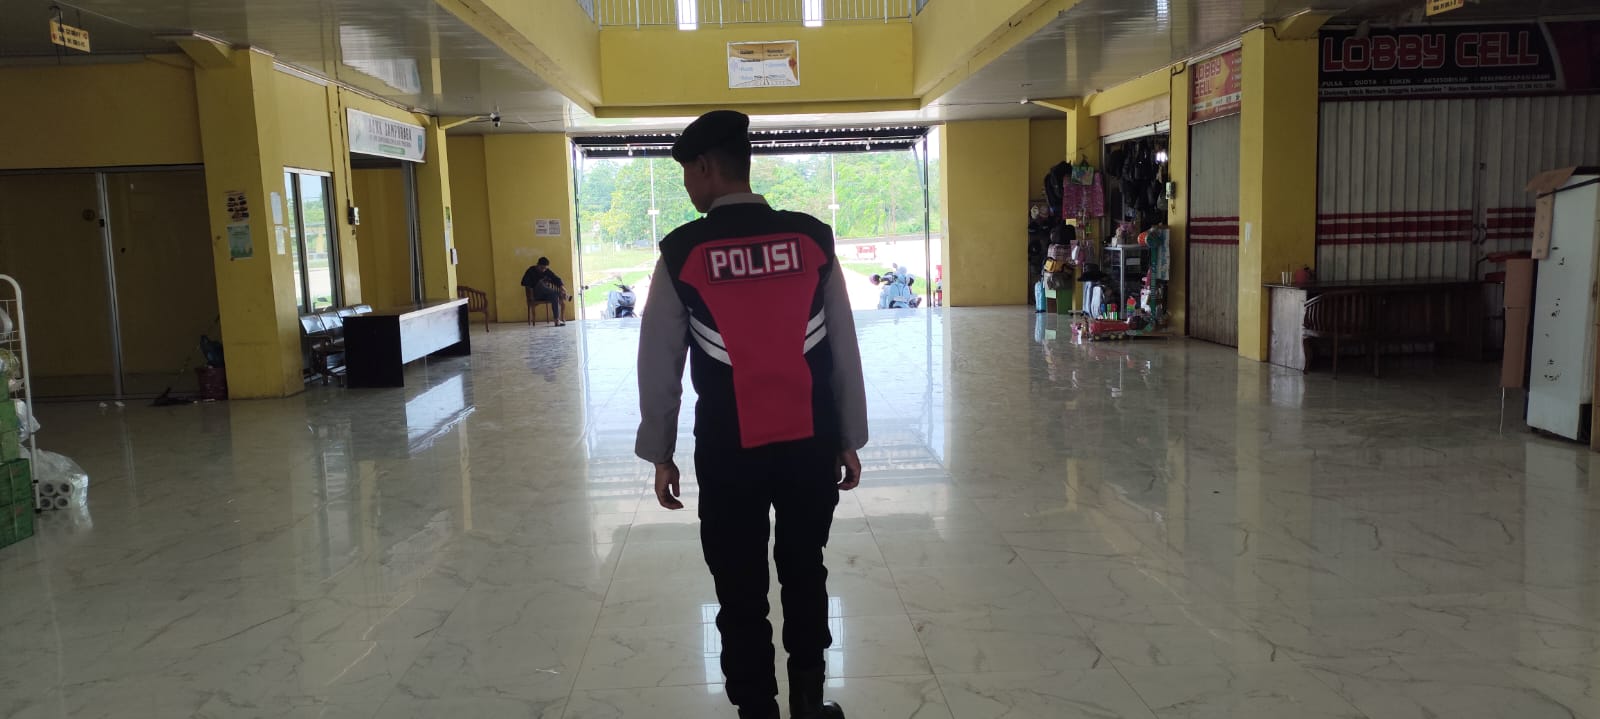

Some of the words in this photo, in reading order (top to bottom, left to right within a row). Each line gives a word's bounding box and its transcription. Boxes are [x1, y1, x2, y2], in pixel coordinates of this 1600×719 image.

[1323, 35, 1446, 72] LOBBY
[1455, 31, 1539, 68] CELL
[710, 242, 798, 278] POLISI
